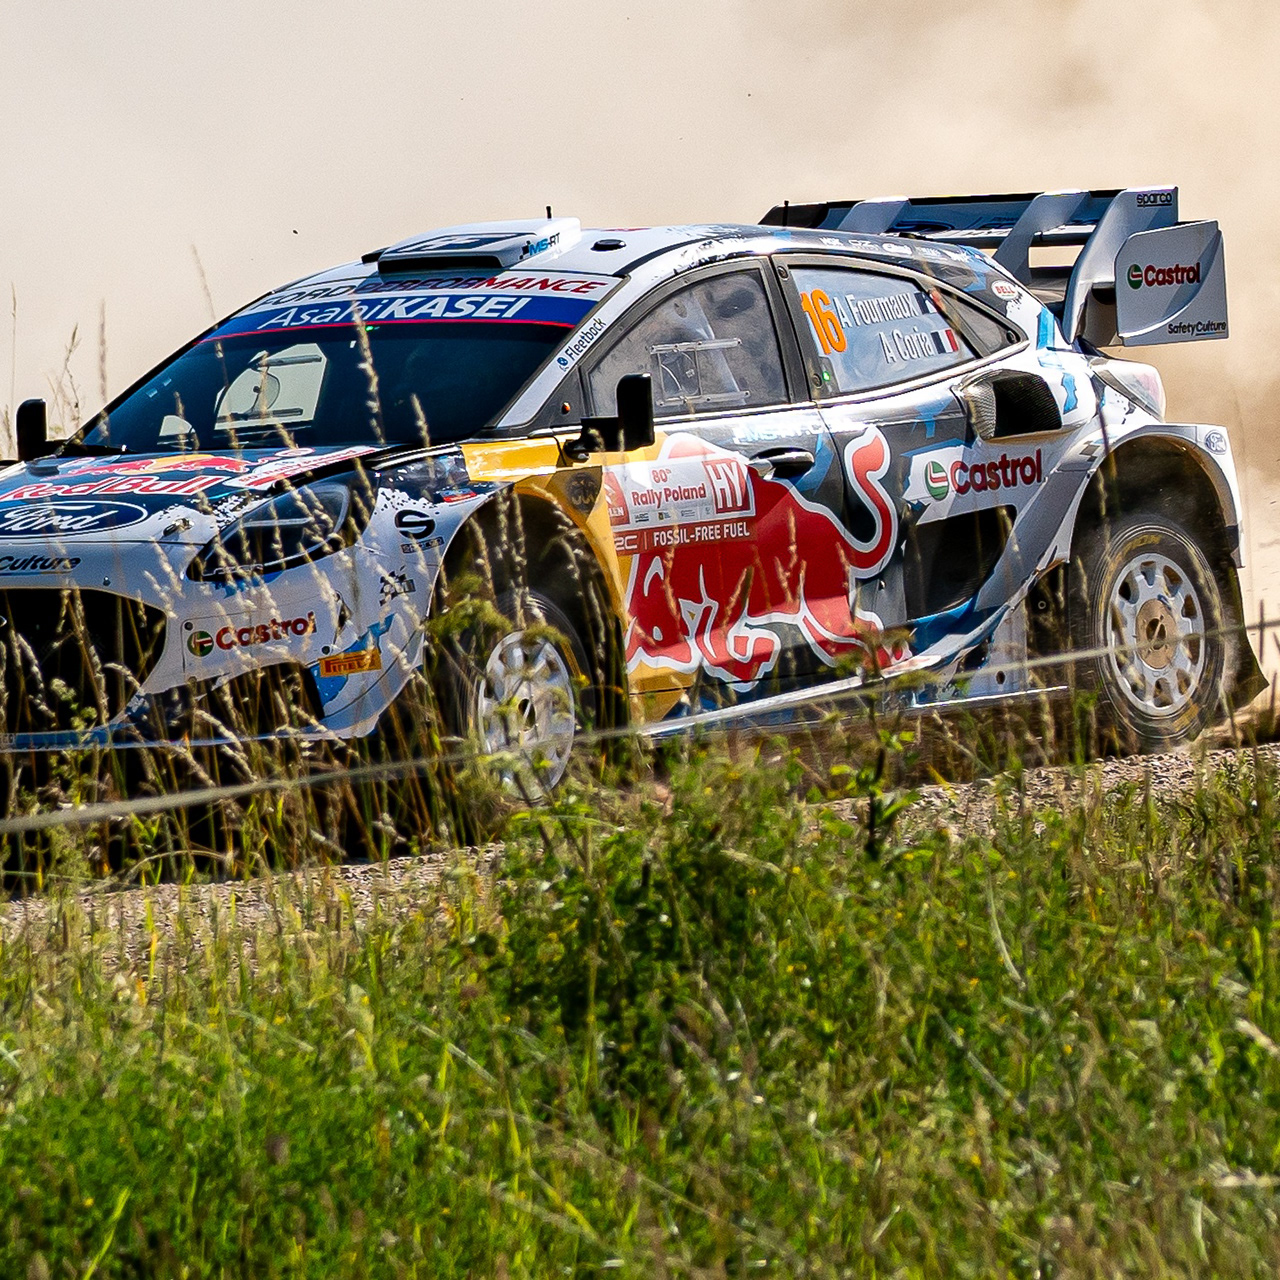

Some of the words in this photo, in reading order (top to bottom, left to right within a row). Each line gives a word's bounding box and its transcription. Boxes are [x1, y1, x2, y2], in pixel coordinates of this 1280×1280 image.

[1137, 192, 1172, 207] sparco
[529, 232, 560, 255] MS-RT
[1144, 262, 1200, 287] Castrol
[251, 285, 356, 310] FORD
[350, 276, 609, 295] PERFORMANCE
[800, 289, 847, 355] 16
[832, 295, 853, 329] A
[845, 292, 919, 326] Fourmaux
[1168, 321, 1227, 336] SafetyCulture
[565, 318, 606, 361] Fleetback
[878, 331, 896, 363] A
[892, 327, 936, 361] Coria
[97, 476, 230, 496] Bull
[707, 462, 743, 509] HY
[950, 448, 1042, 495] Castrol
[632, 489, 663, 508] Rally
[664, 483, 706, 503] Poland
[653, 525, 721, 546] FOSSIL-FREE
[723, 522, 750, 538] FUEL
[216, 611, 317, 650] Castrol
